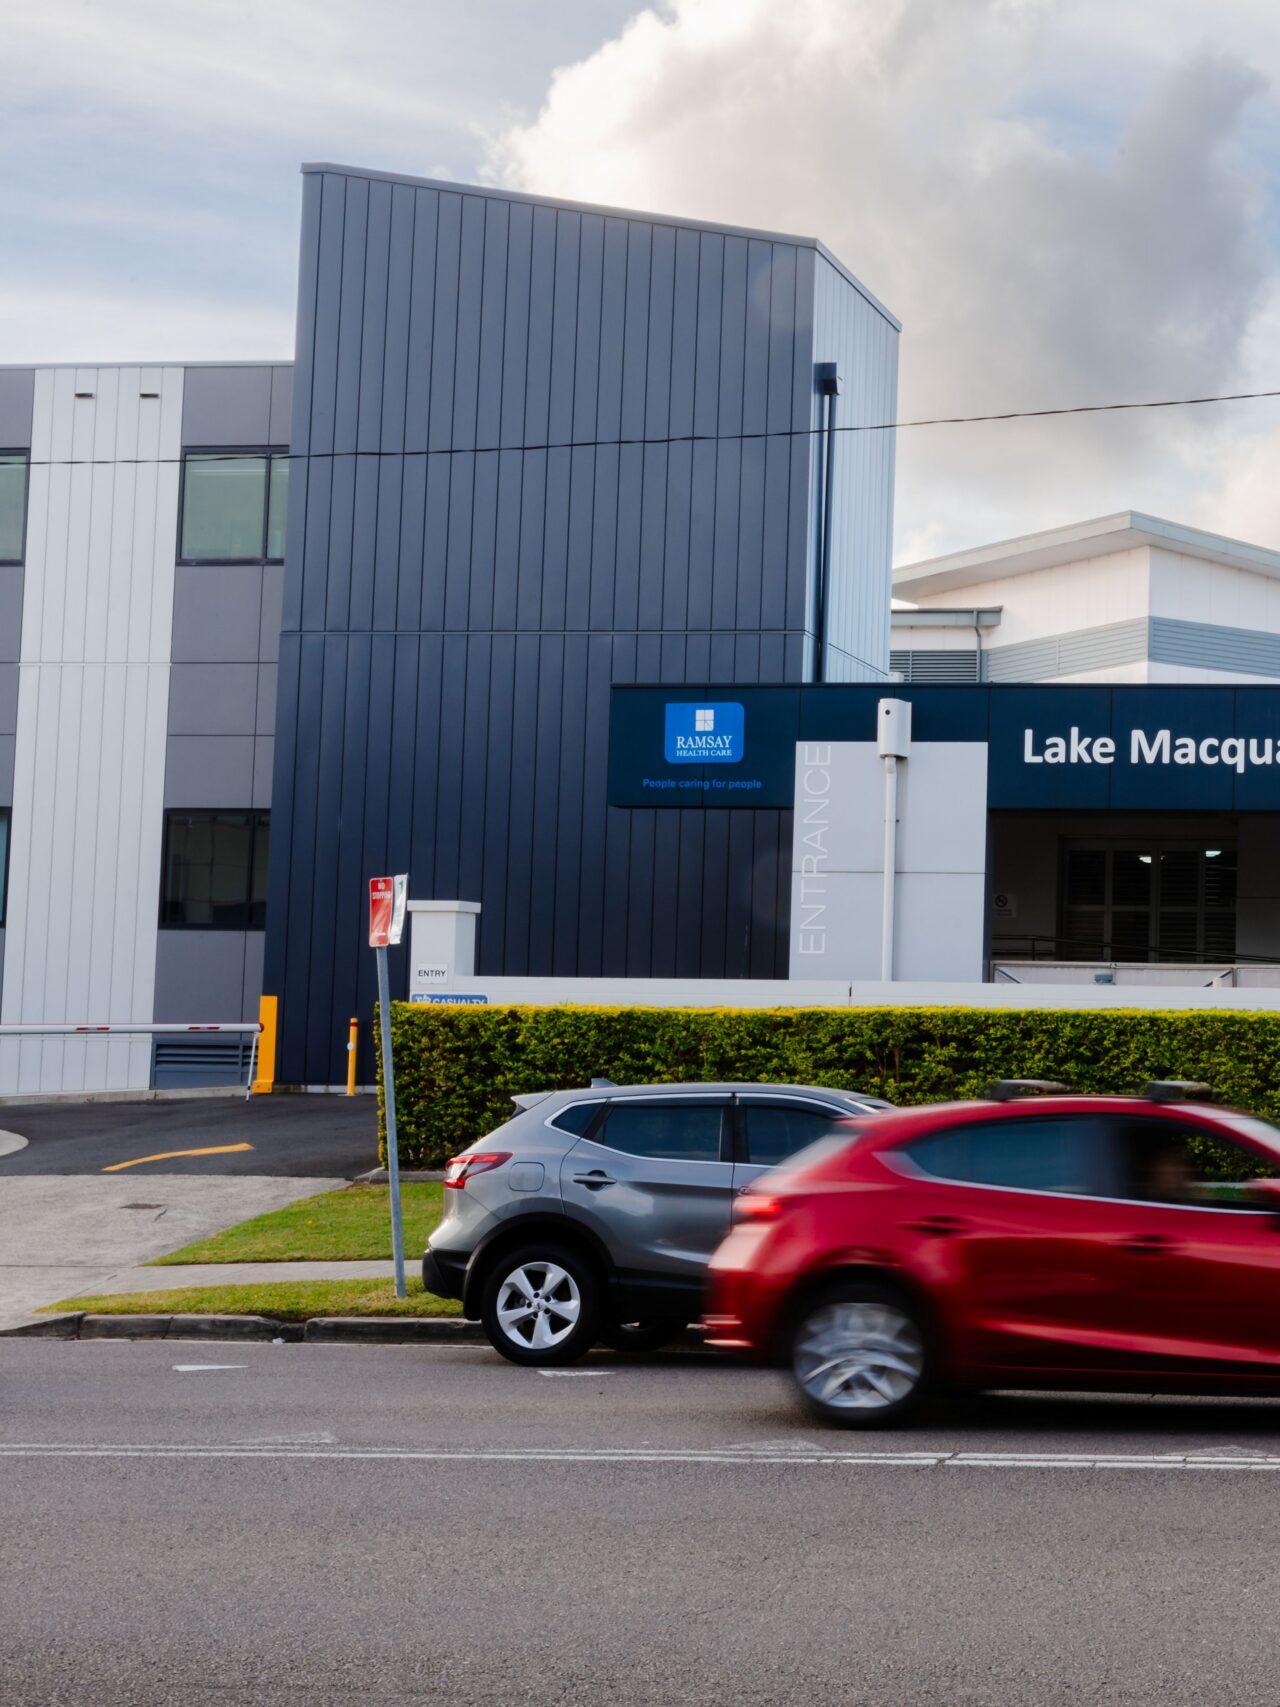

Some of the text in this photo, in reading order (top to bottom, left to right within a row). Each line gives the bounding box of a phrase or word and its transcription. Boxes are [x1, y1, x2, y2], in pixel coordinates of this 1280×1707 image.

[676, 735, 733, 749] RAMSAY
[1023, 726, 1116, 764] Lake
[676, 749, 732, 757] HEALTH CARE
[642, 778, 763, 791] People caring for people
[799, 744, 832, 955] ENTRANCE
[418, 969, 446, 977] ENTRY
